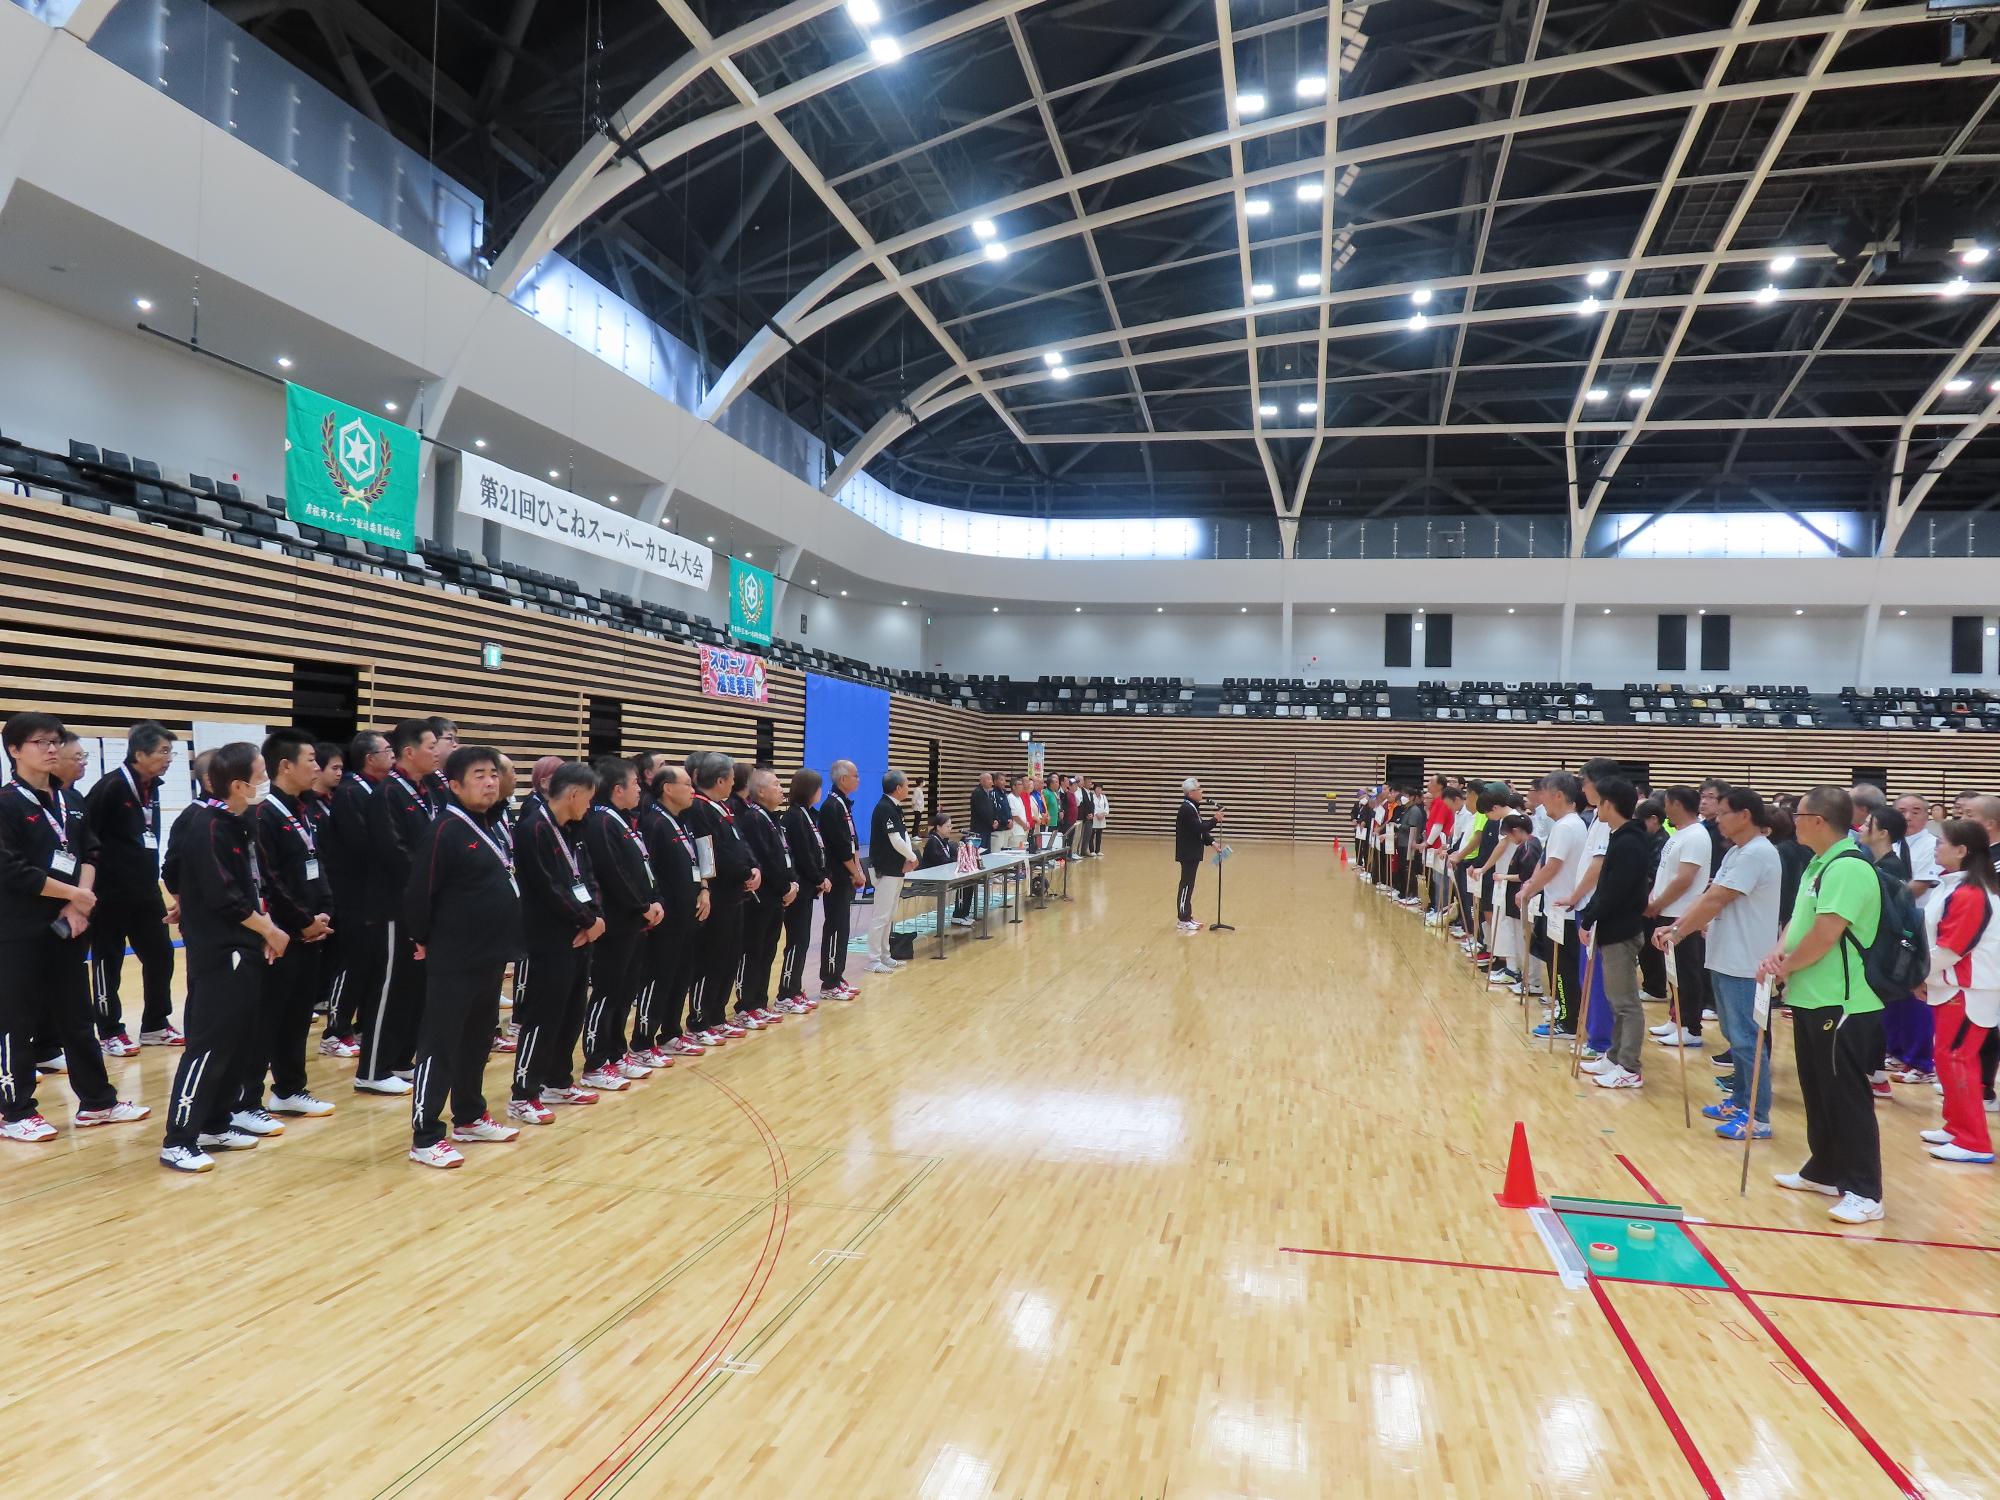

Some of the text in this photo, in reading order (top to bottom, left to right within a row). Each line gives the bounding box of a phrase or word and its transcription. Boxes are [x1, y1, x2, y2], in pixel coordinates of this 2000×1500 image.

[480, 474, 704, 581] 第21回ひこねスーパーカロム大会
[710, 649, 746, 675] スポーツ
